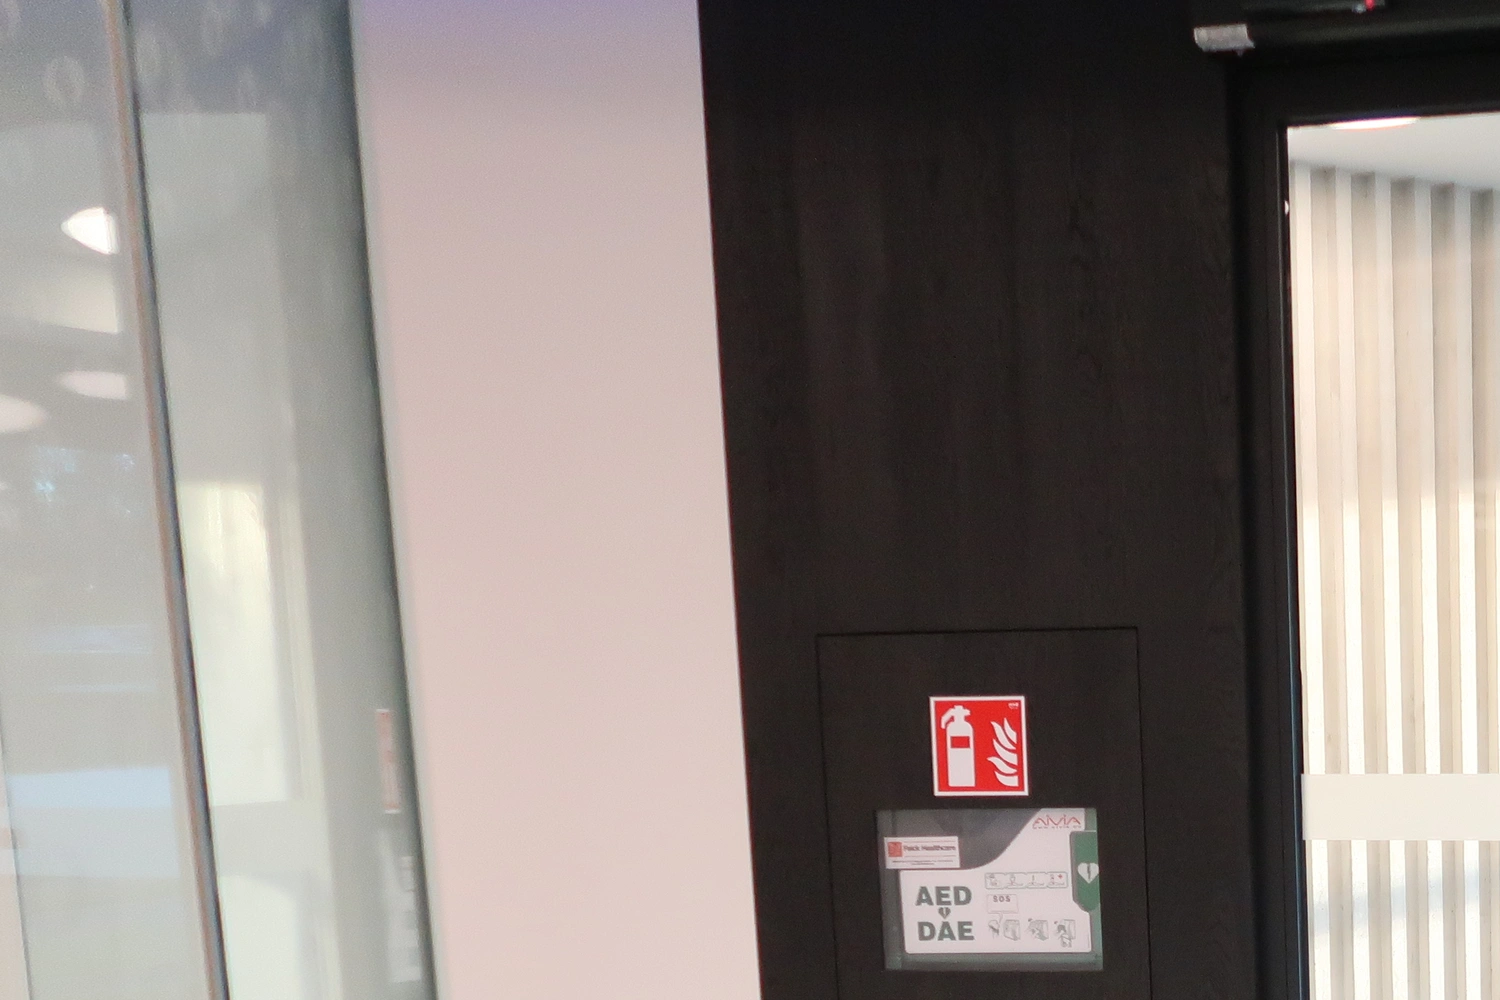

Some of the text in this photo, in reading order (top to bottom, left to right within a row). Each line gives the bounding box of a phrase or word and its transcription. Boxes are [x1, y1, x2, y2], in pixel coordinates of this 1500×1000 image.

[915, 886, 972, 906] AED
[992, 895, 1012, 903] SOS
[917, 920, 975, 942] DAE
